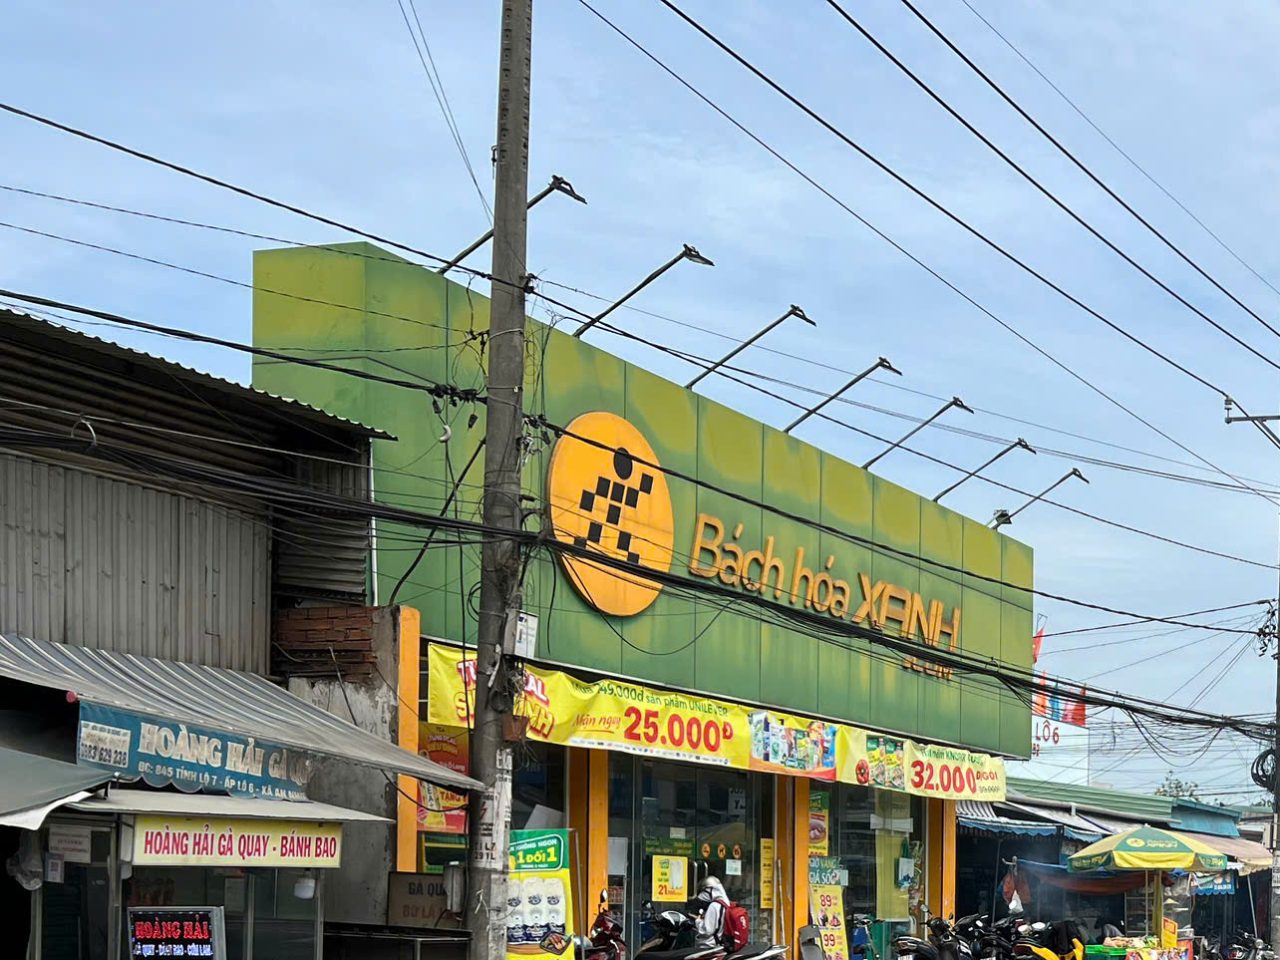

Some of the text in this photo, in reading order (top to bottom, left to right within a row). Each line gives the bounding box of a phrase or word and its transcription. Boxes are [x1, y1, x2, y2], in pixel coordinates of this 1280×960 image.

[688, 513, 960, 653] Bách hóa XANH
[137, 722, 222, 768] HOÀNG
[225, 737, 265, 777] HẢI
[143, 825, 189, 856] HOÀNG
[192, 824, 215, 856] HẢI
[217, 827, 234, 856] GÀ
[238, 834, 270, 860] QUAY
[280, 829, 312, 858] BÁNH
[314, 836, 337, 858] BAO
[547, 847, 557, 862] 1
[135, 914, 209, 939] HOÀNG HẢI
